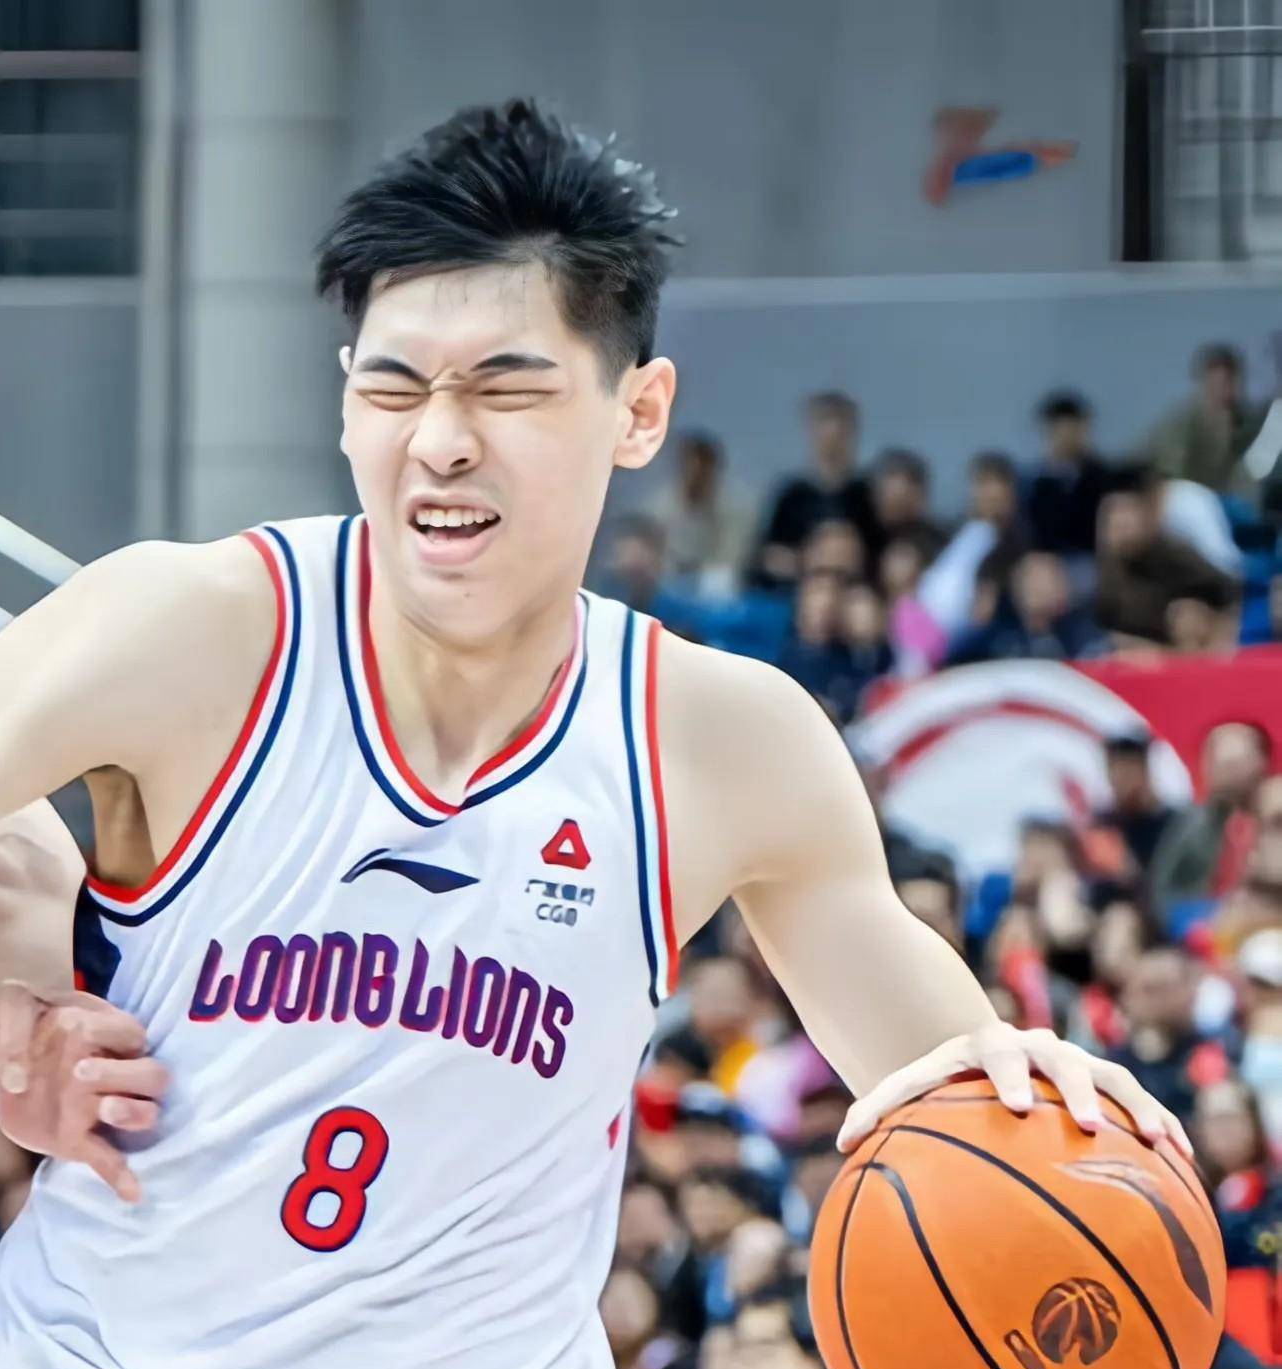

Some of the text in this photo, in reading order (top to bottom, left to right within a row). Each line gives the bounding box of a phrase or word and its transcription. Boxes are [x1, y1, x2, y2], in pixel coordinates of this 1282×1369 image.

[188, 930, 575, 1079] LOONG LIONS
[280, 1105, 390, 1253] 8
